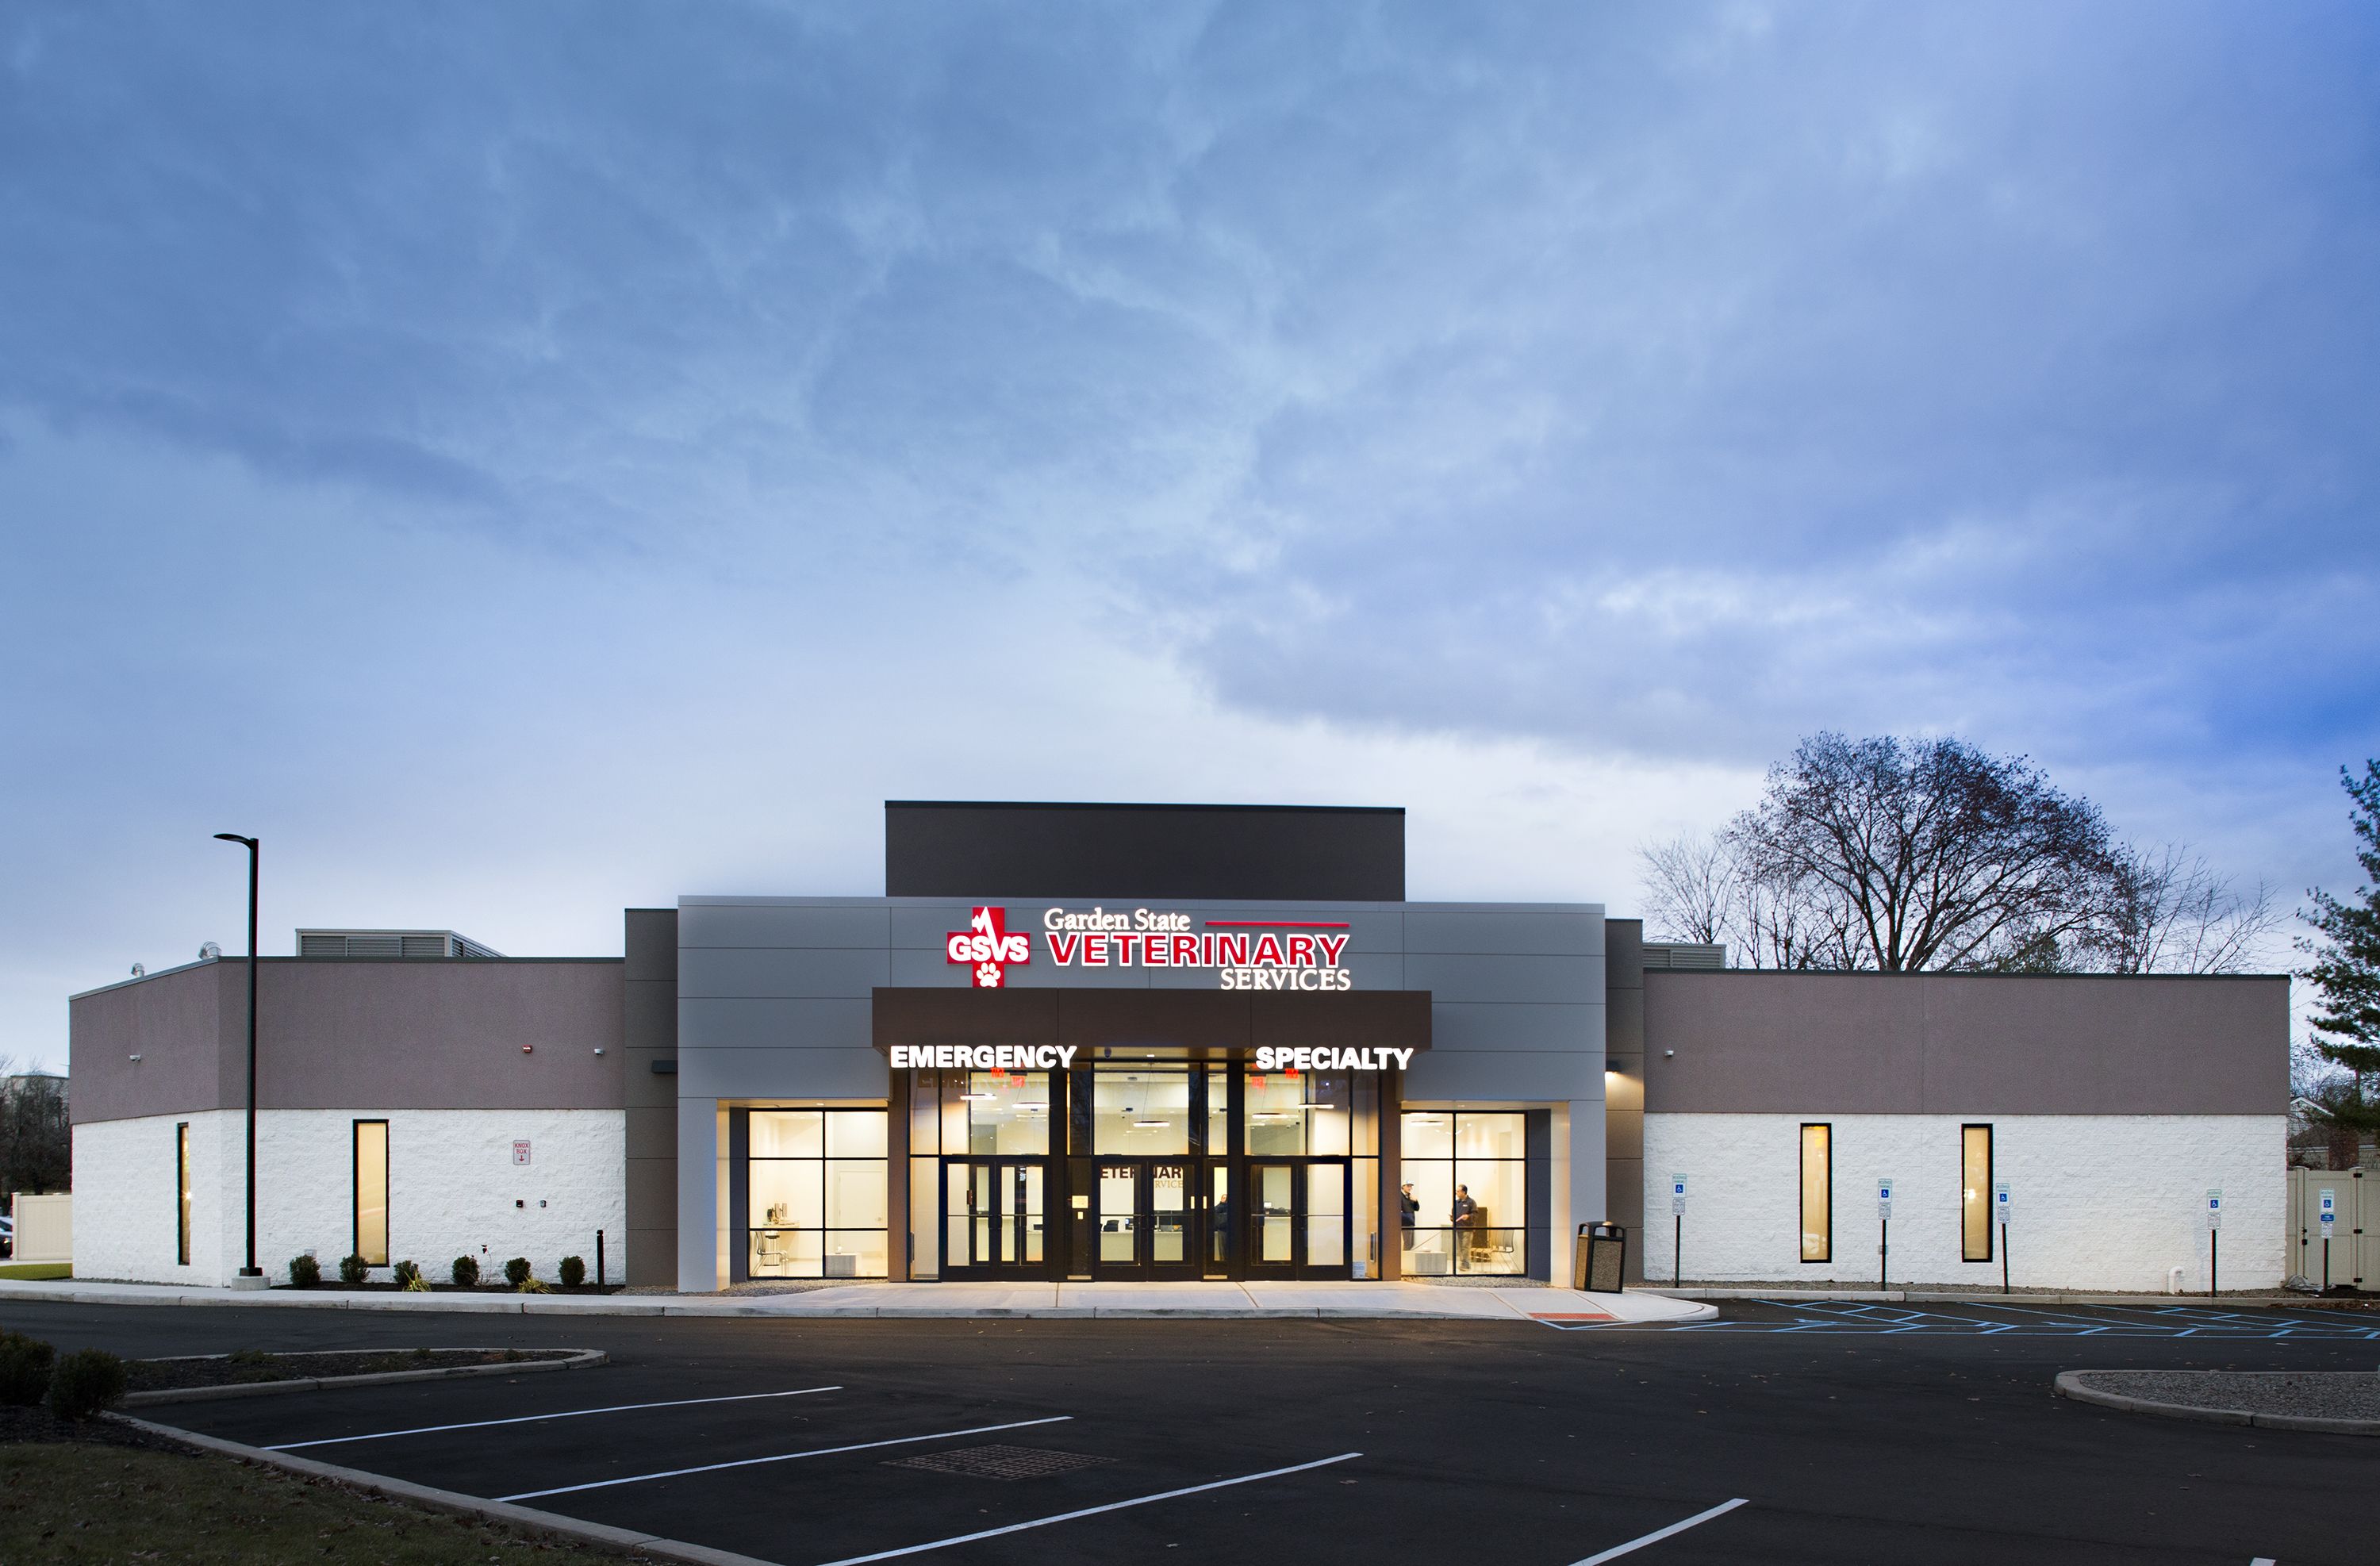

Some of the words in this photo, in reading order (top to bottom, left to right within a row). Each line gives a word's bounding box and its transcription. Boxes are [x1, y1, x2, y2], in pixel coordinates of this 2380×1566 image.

[1044, 907, 1130, 931] Garden
[1134, 908, 1191, 931] State
[948, 934, 1029, 962] GSVS
[1045, 931, 1350, 969] VETERINARY
[1220, 968, 1351, 991] SERVICES
[890, 1045, 1077, 1069] EMERGENCY
[1256, 1046, 1414, 1070] SPECIALTY
